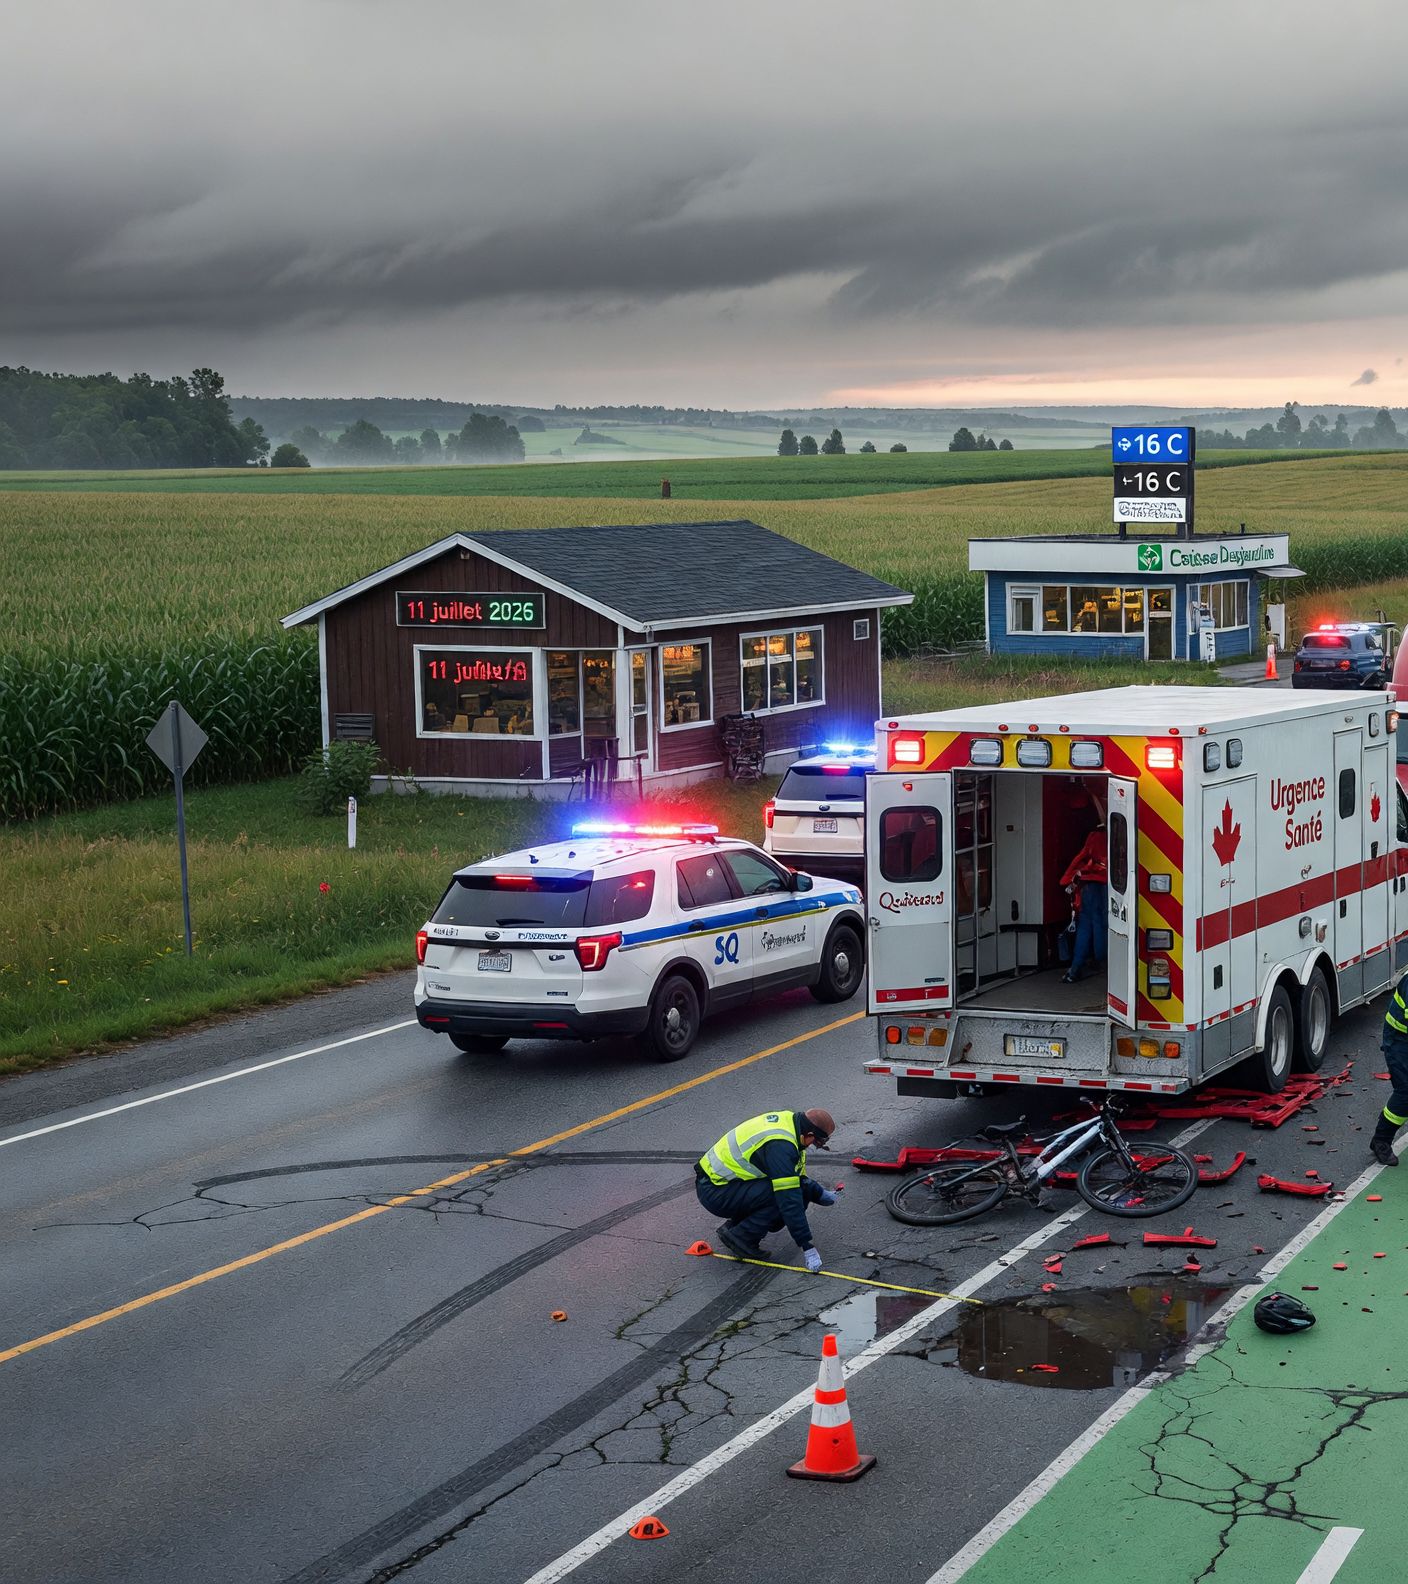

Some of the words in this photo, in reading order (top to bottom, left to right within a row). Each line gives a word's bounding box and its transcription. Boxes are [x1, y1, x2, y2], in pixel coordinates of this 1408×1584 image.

[1167, 433, 1183, 455] C
[1166, 471, 1181, 492] C
[408, 601, 424, 619] 11
[430, 601, 482, 623] juillet
[489, 602, 534, 621] 2026
[429, 661, 446, 679] 11
[1270, 776, 1326, 816] Urgence
[1285, 809, 1323, 851] Santé
[714, 932, 740, 966] SQ
